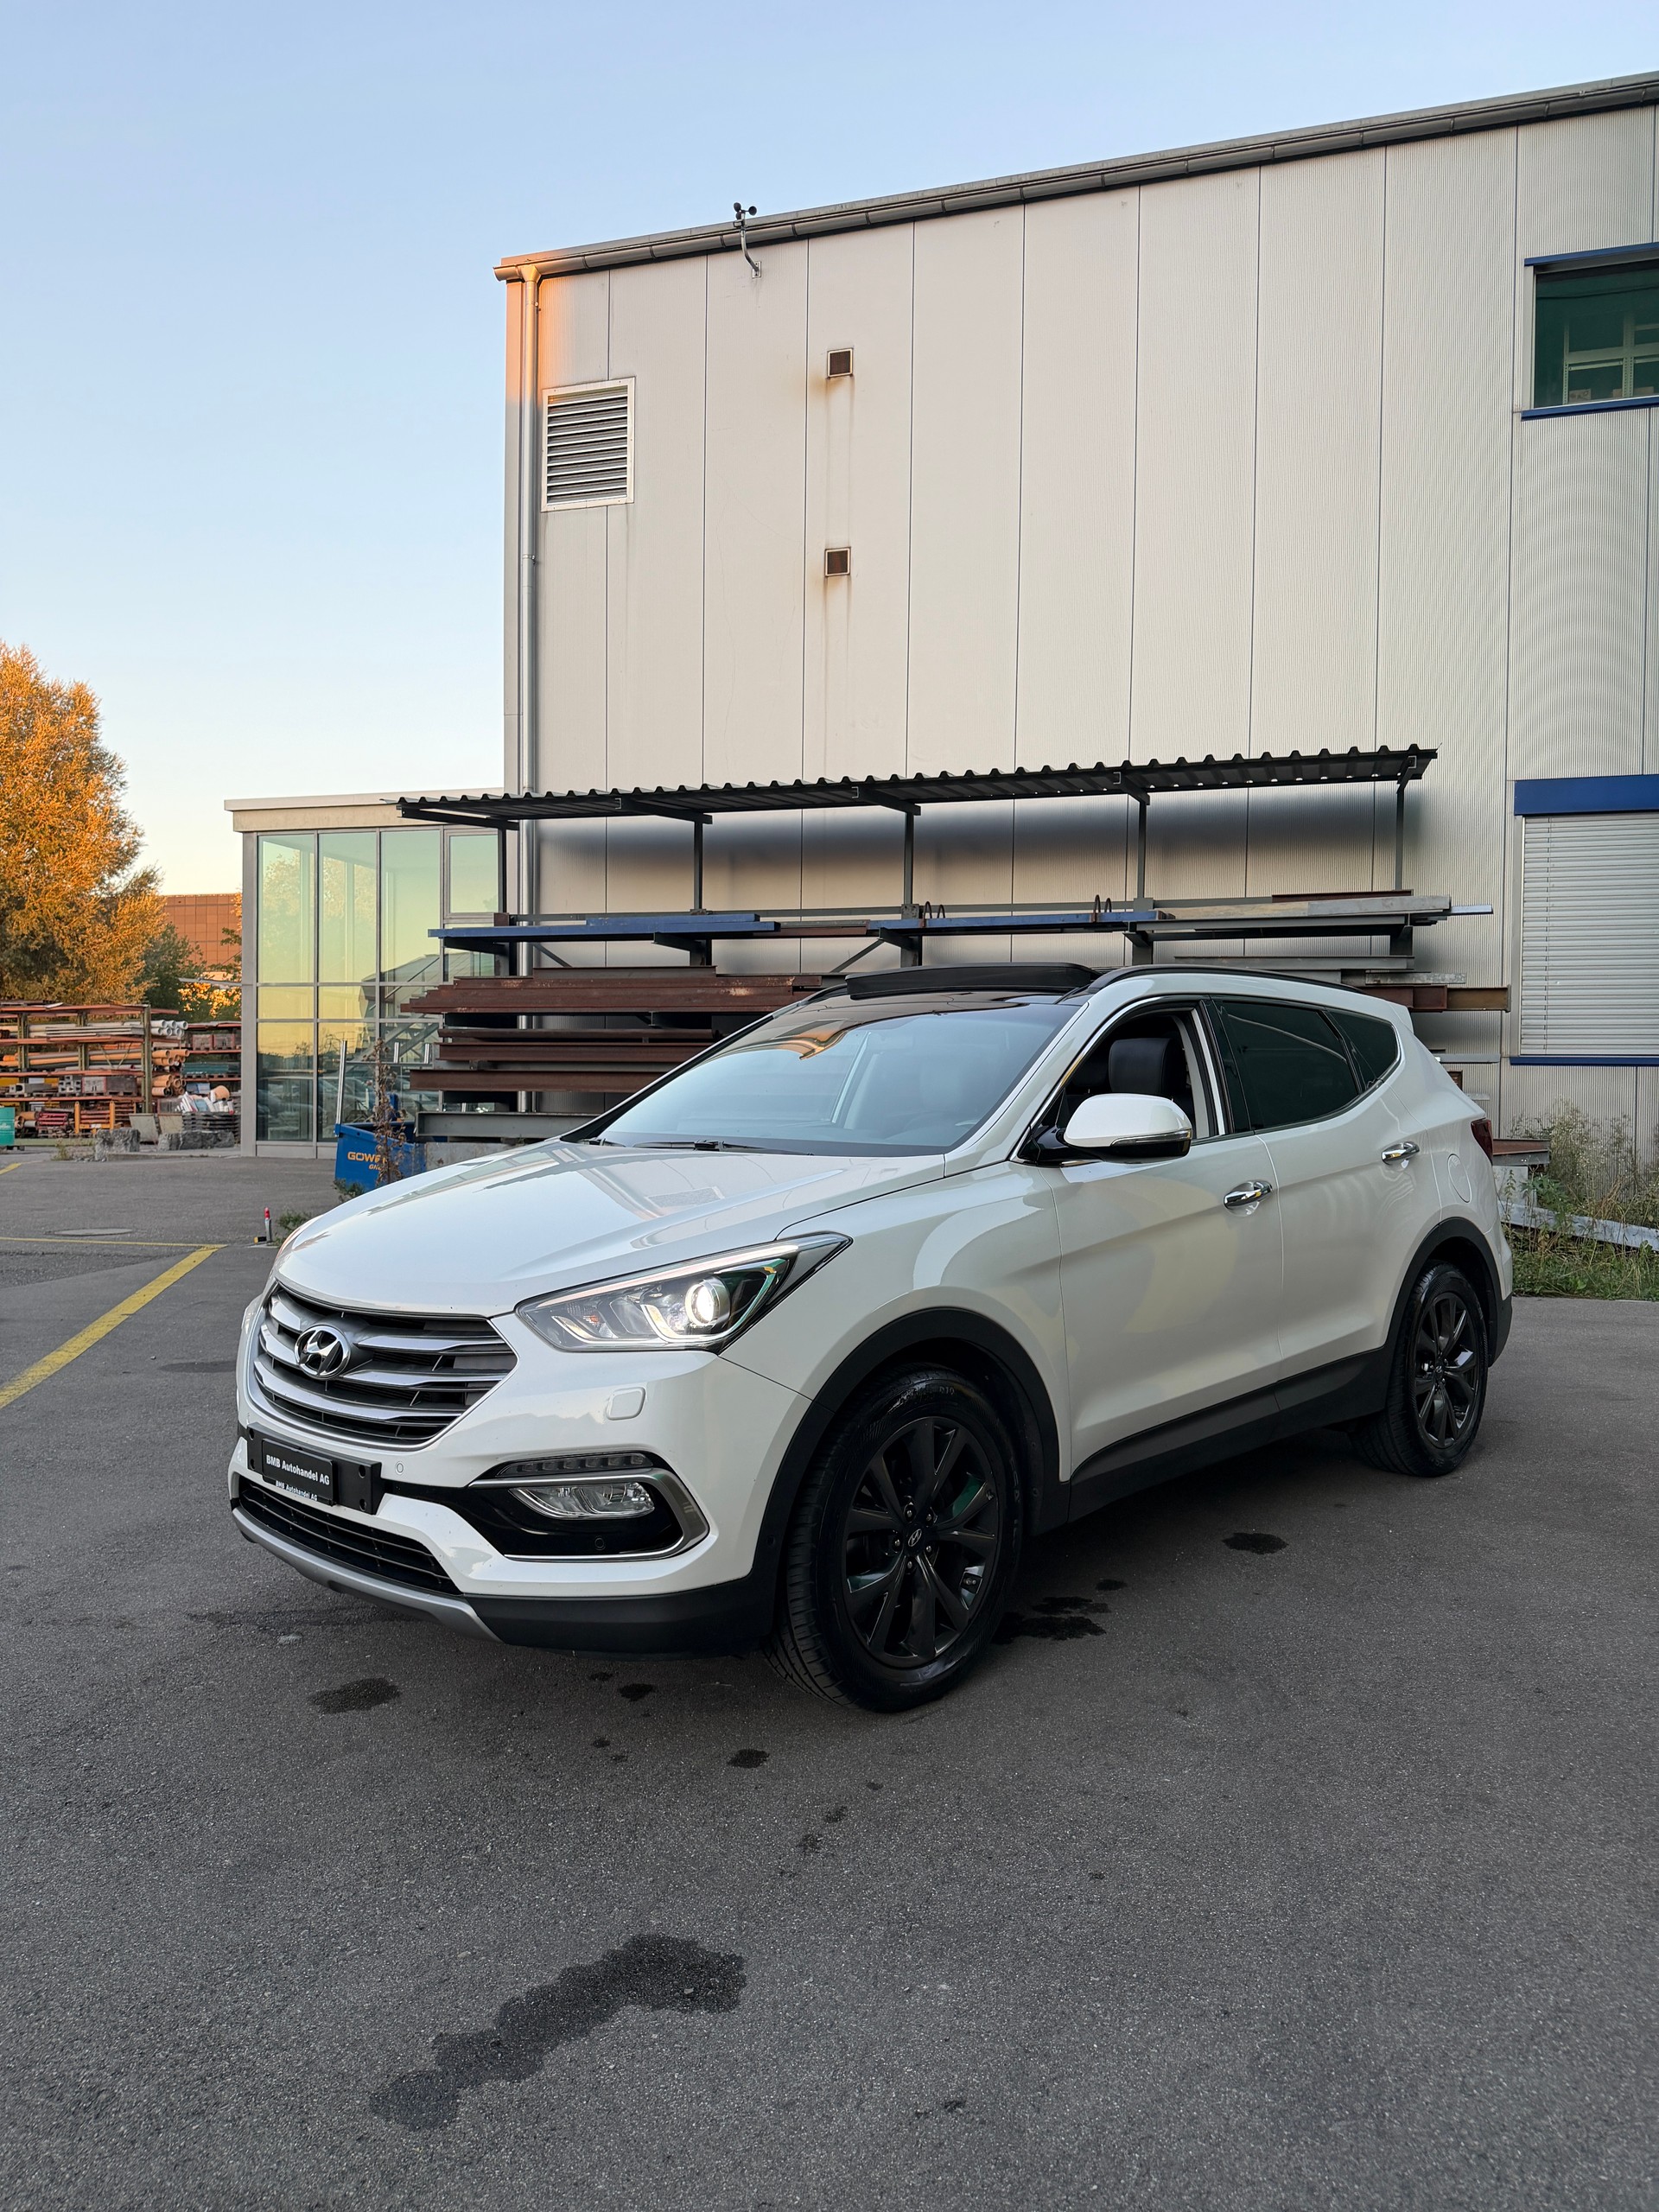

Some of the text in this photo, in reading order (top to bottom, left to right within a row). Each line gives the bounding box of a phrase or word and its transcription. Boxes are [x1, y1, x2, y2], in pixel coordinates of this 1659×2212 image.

[266, 1454, 330, 1485] BMB Autohandel AG
[310, 1493, 318, 1502] AG
